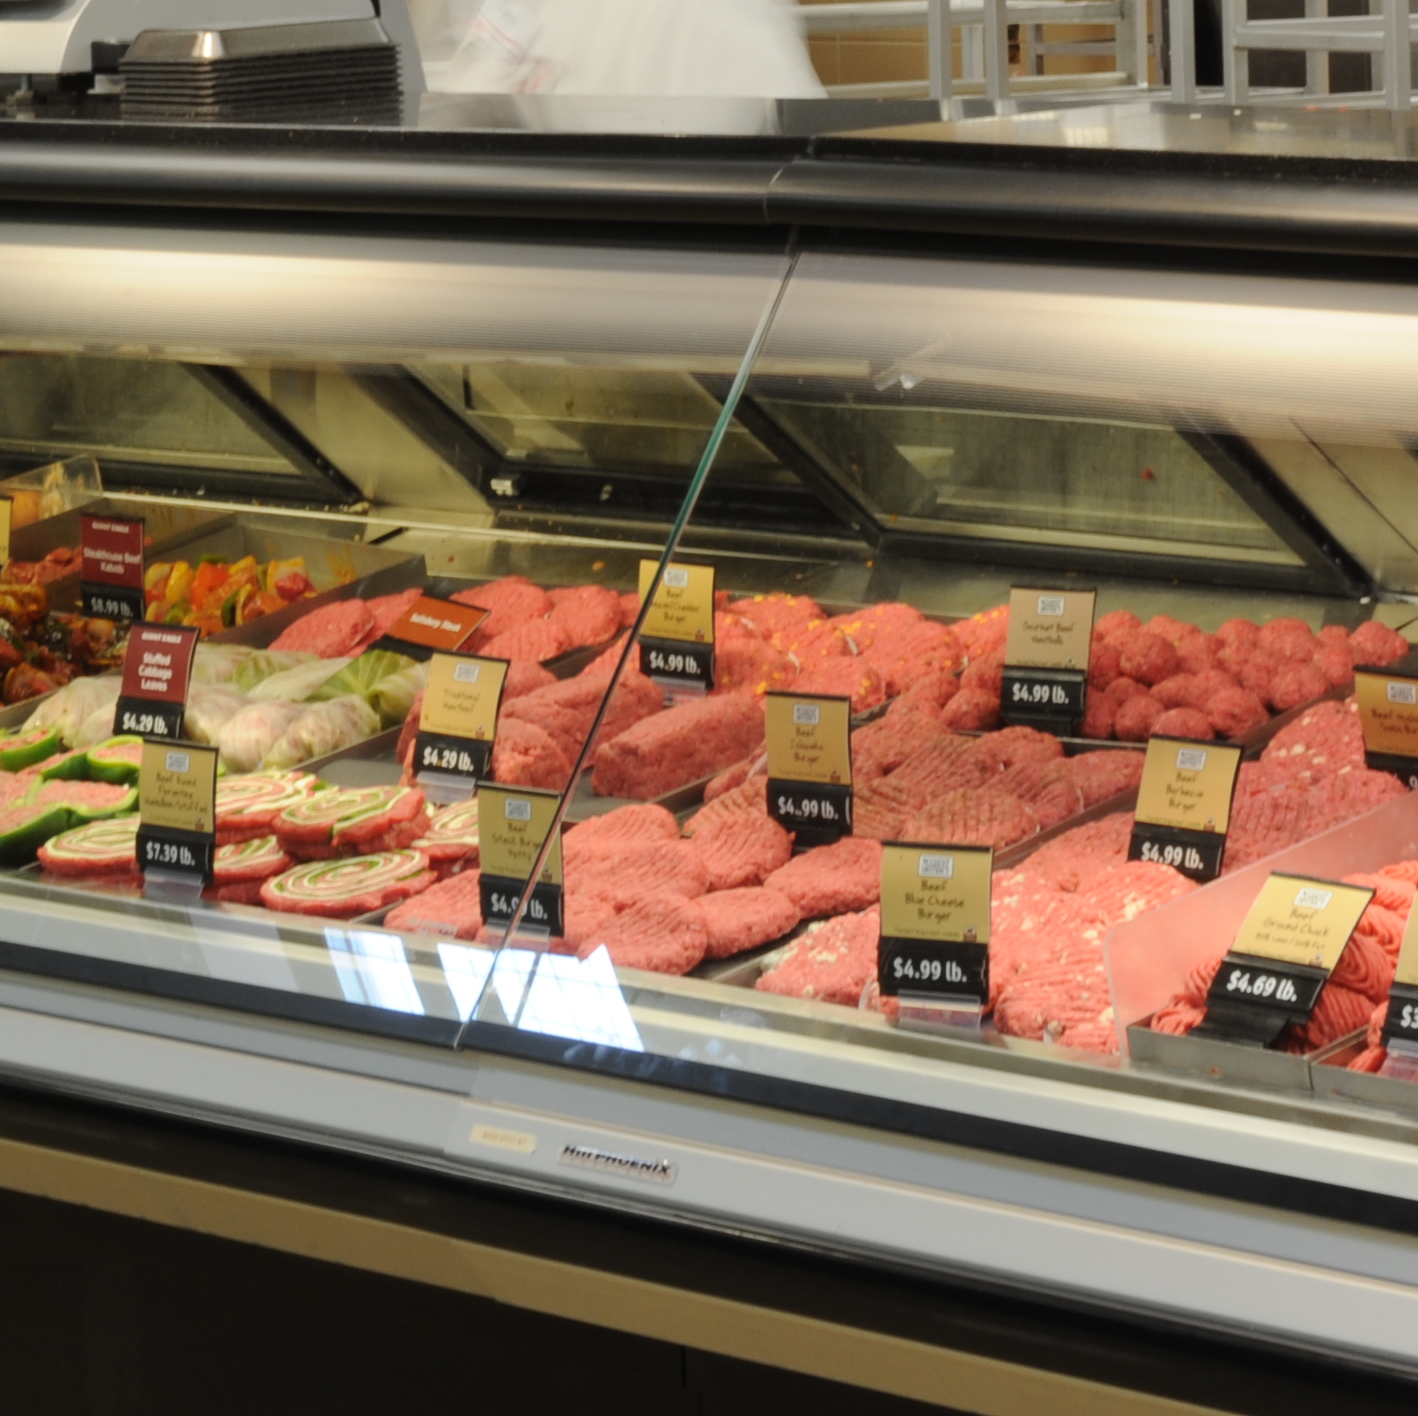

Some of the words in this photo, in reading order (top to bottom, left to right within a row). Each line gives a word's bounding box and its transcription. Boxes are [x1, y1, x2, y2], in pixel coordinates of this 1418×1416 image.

[143, 652, 171, 666] Stuffed
[649, 650, 683, 672] $4.99
[685, 655, 701, 674] lb.
[138, 665, 173, 680] Cabbage
[141, 678, 168, 692] Leaves
[1012, 682, 1050, 703] $4.99
[1052, 685, 1069, 704] lb.
[122, 712, 153, 732] $4.29
[155, 715, 168, 734] lb.
[423, 745, 459, 769] $4.29
[458, 752, 475, 772] lb.
[146, 841, 178, 863] $7.39
[180, 846, 195, 867] lb.
[1141, 841, 1183, 866] $4.99
[1185, 847, 1204, 870] lb.
[921, 879, 948, 892] Beef
[917, 907, 952, 924] Burger
[1263, 917, 1299, 932] Ground
[1299, 923, 1330, 937] Chuck
[893, 956, 941, 981] $4.99
[945, 960, 968, 983] lb.
[1226, 969, 1277, 997] $4.69
[1276, 978, 1297, 1002] lb.
